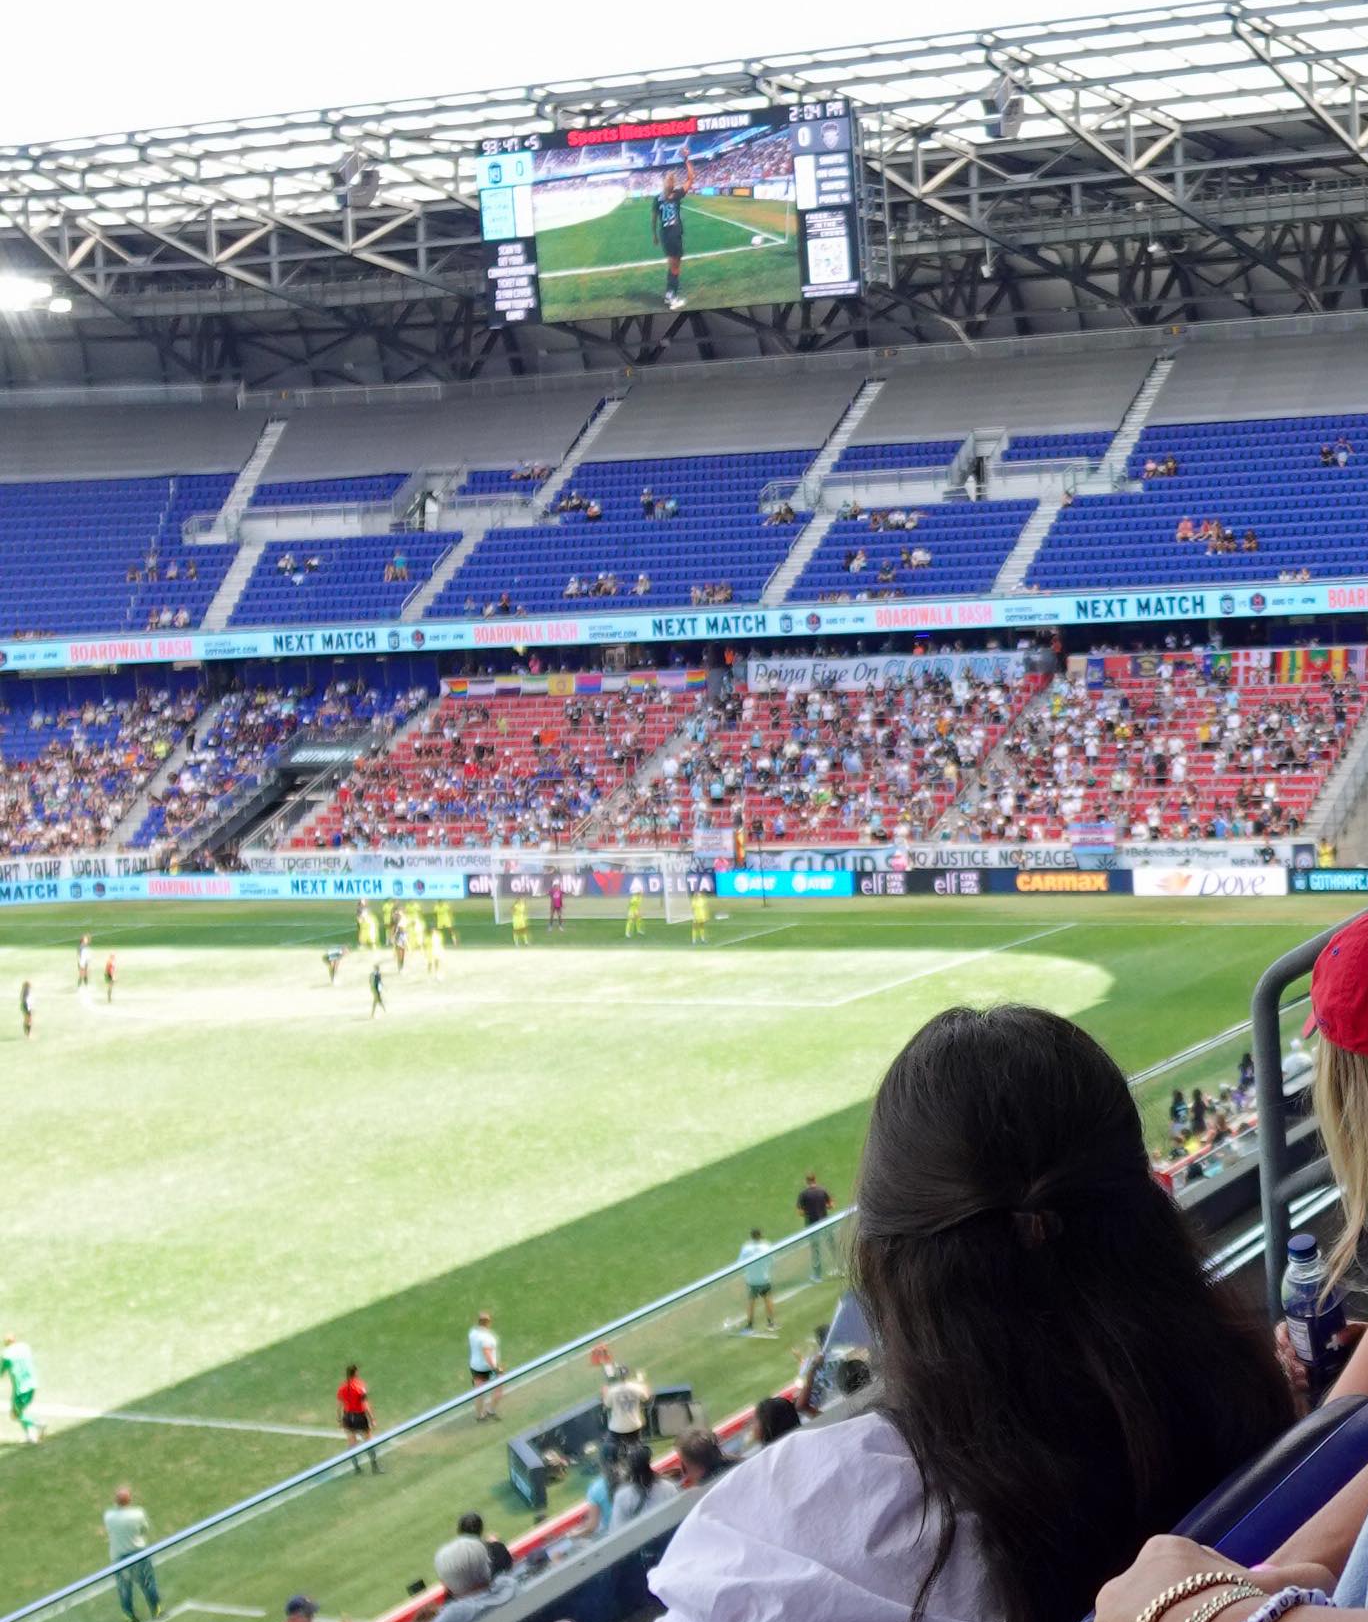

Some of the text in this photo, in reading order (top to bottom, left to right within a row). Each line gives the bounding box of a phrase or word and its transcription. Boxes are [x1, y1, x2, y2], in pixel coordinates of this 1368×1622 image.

[789, 101, 844, 122] 2:04 PM
[567, 114, 750, 147] Sports Illustrated STADIUM
[875, 604, 993, 628] BOARDWALK BASH
[1076, 595, 1205, 620] NEXT MATCH
[473, 623, 578, 644] BOARDWALK BASH
[652, 614, 767, 637] NEXT MATCH
[70, 639, 193, 663] BOARDWALK BASH
[273, 631, 376, 652] NEXT MATCH
[854, 662, 878, 682] On
[26, 860, 61, 879] YOUR
[117, 856, 149, 875] TEAM
[280, 857, 341, 869] TOGETHER
[790, 854, 877, 871] CLOUD
[908, 850, 927, 866] NO
[931, 850, 993, 867] JUSTICE.
[0, 883, 58, 901] MATCH
[291, 880, 327, 895] NEXT
[334, 879, 382, 894] MATCH
[1200, 872, 1266, 897] Dove
